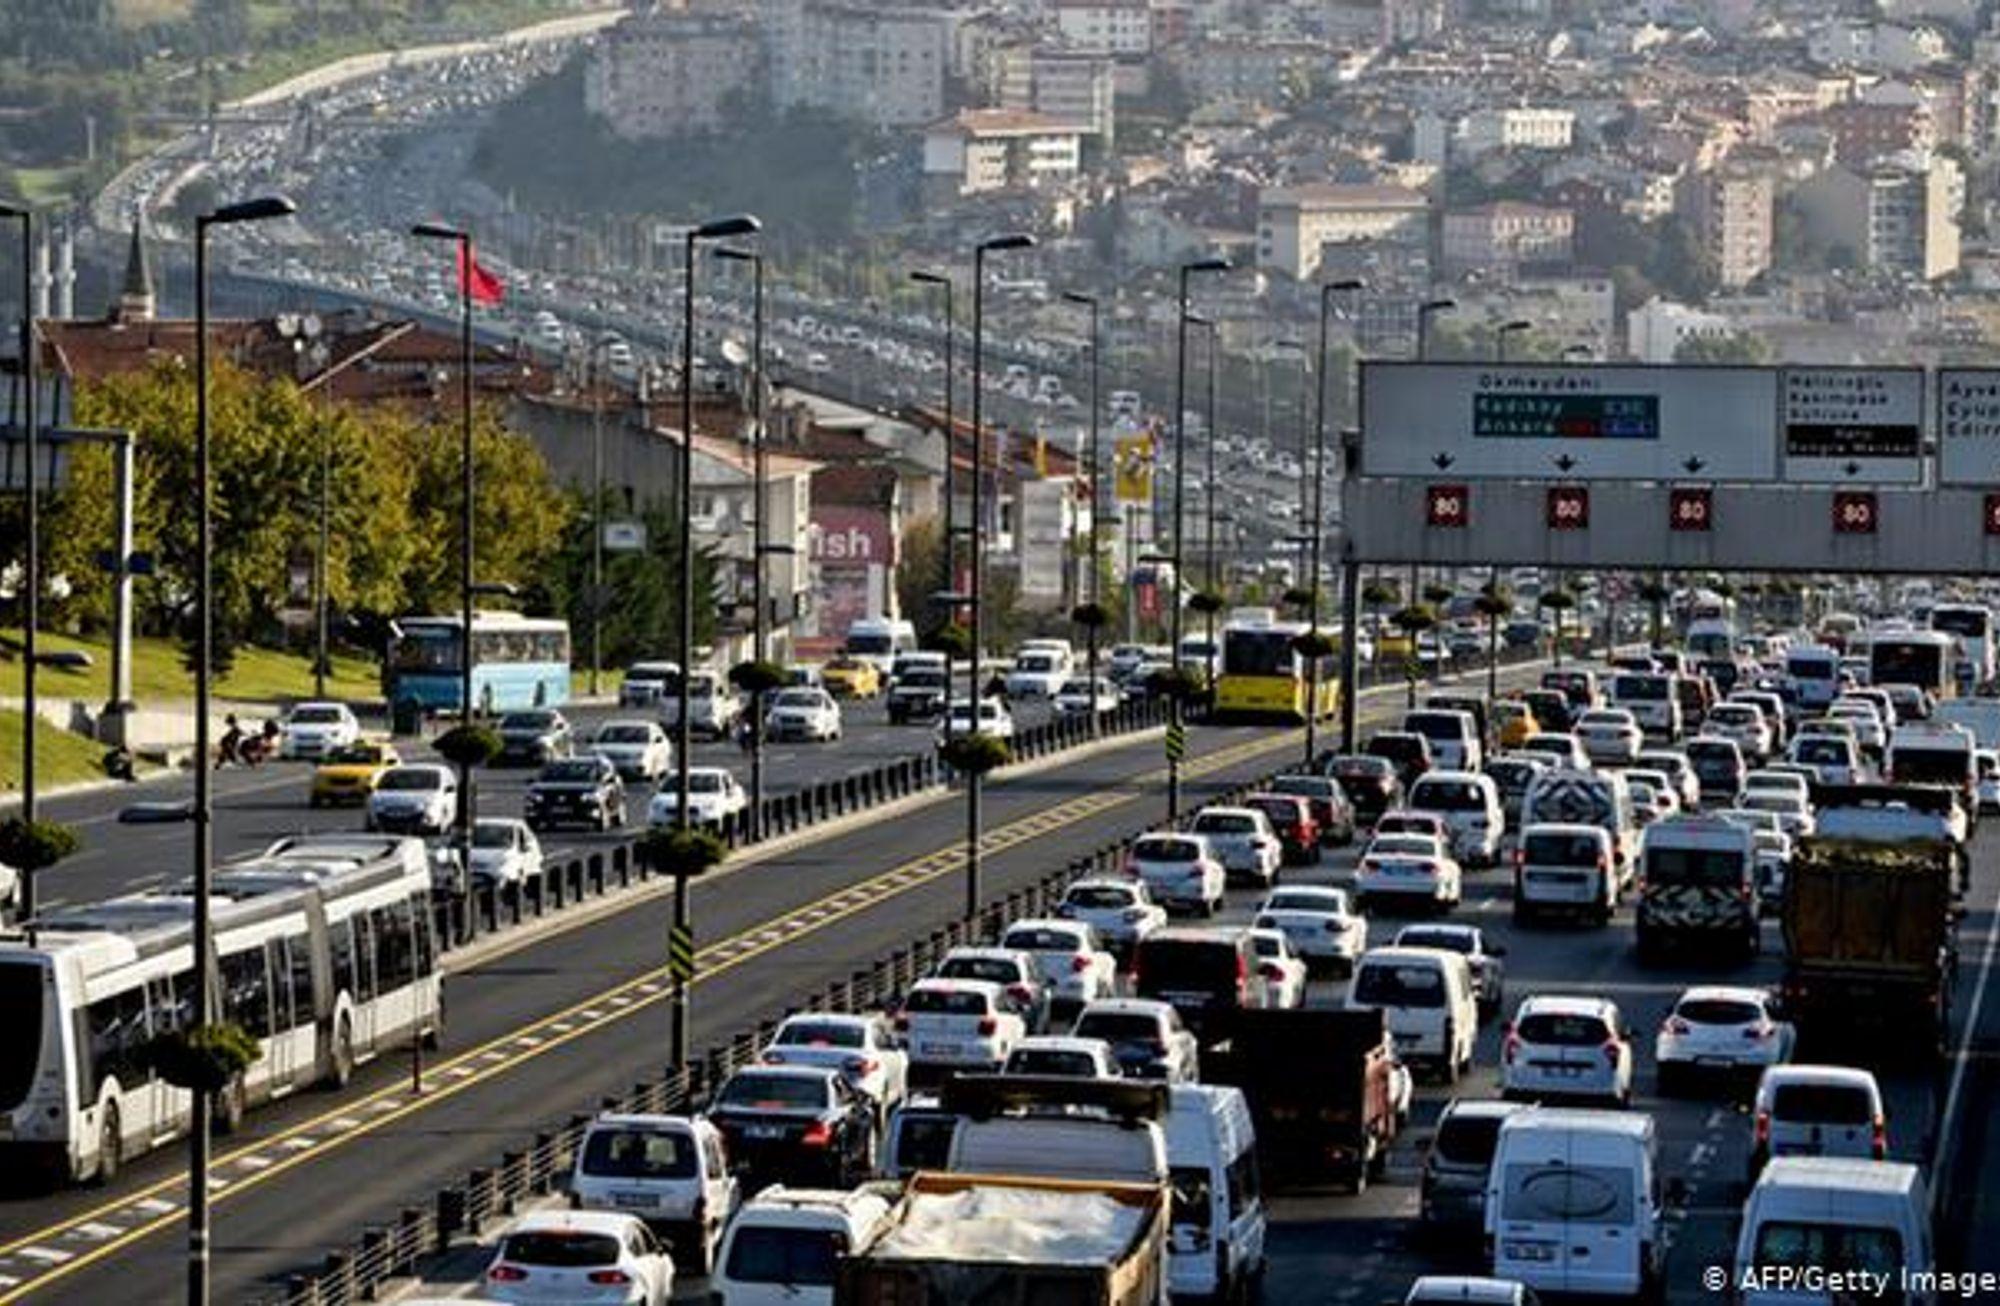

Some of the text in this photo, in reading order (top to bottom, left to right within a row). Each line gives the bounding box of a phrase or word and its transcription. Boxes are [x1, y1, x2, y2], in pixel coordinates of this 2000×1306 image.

[1435, 499, 1460, 516] 80
[1556, 501, 1580, 517] 80
[1680, 502, 1704, 519] 80
[1843, 504, 1868, 522] 80
